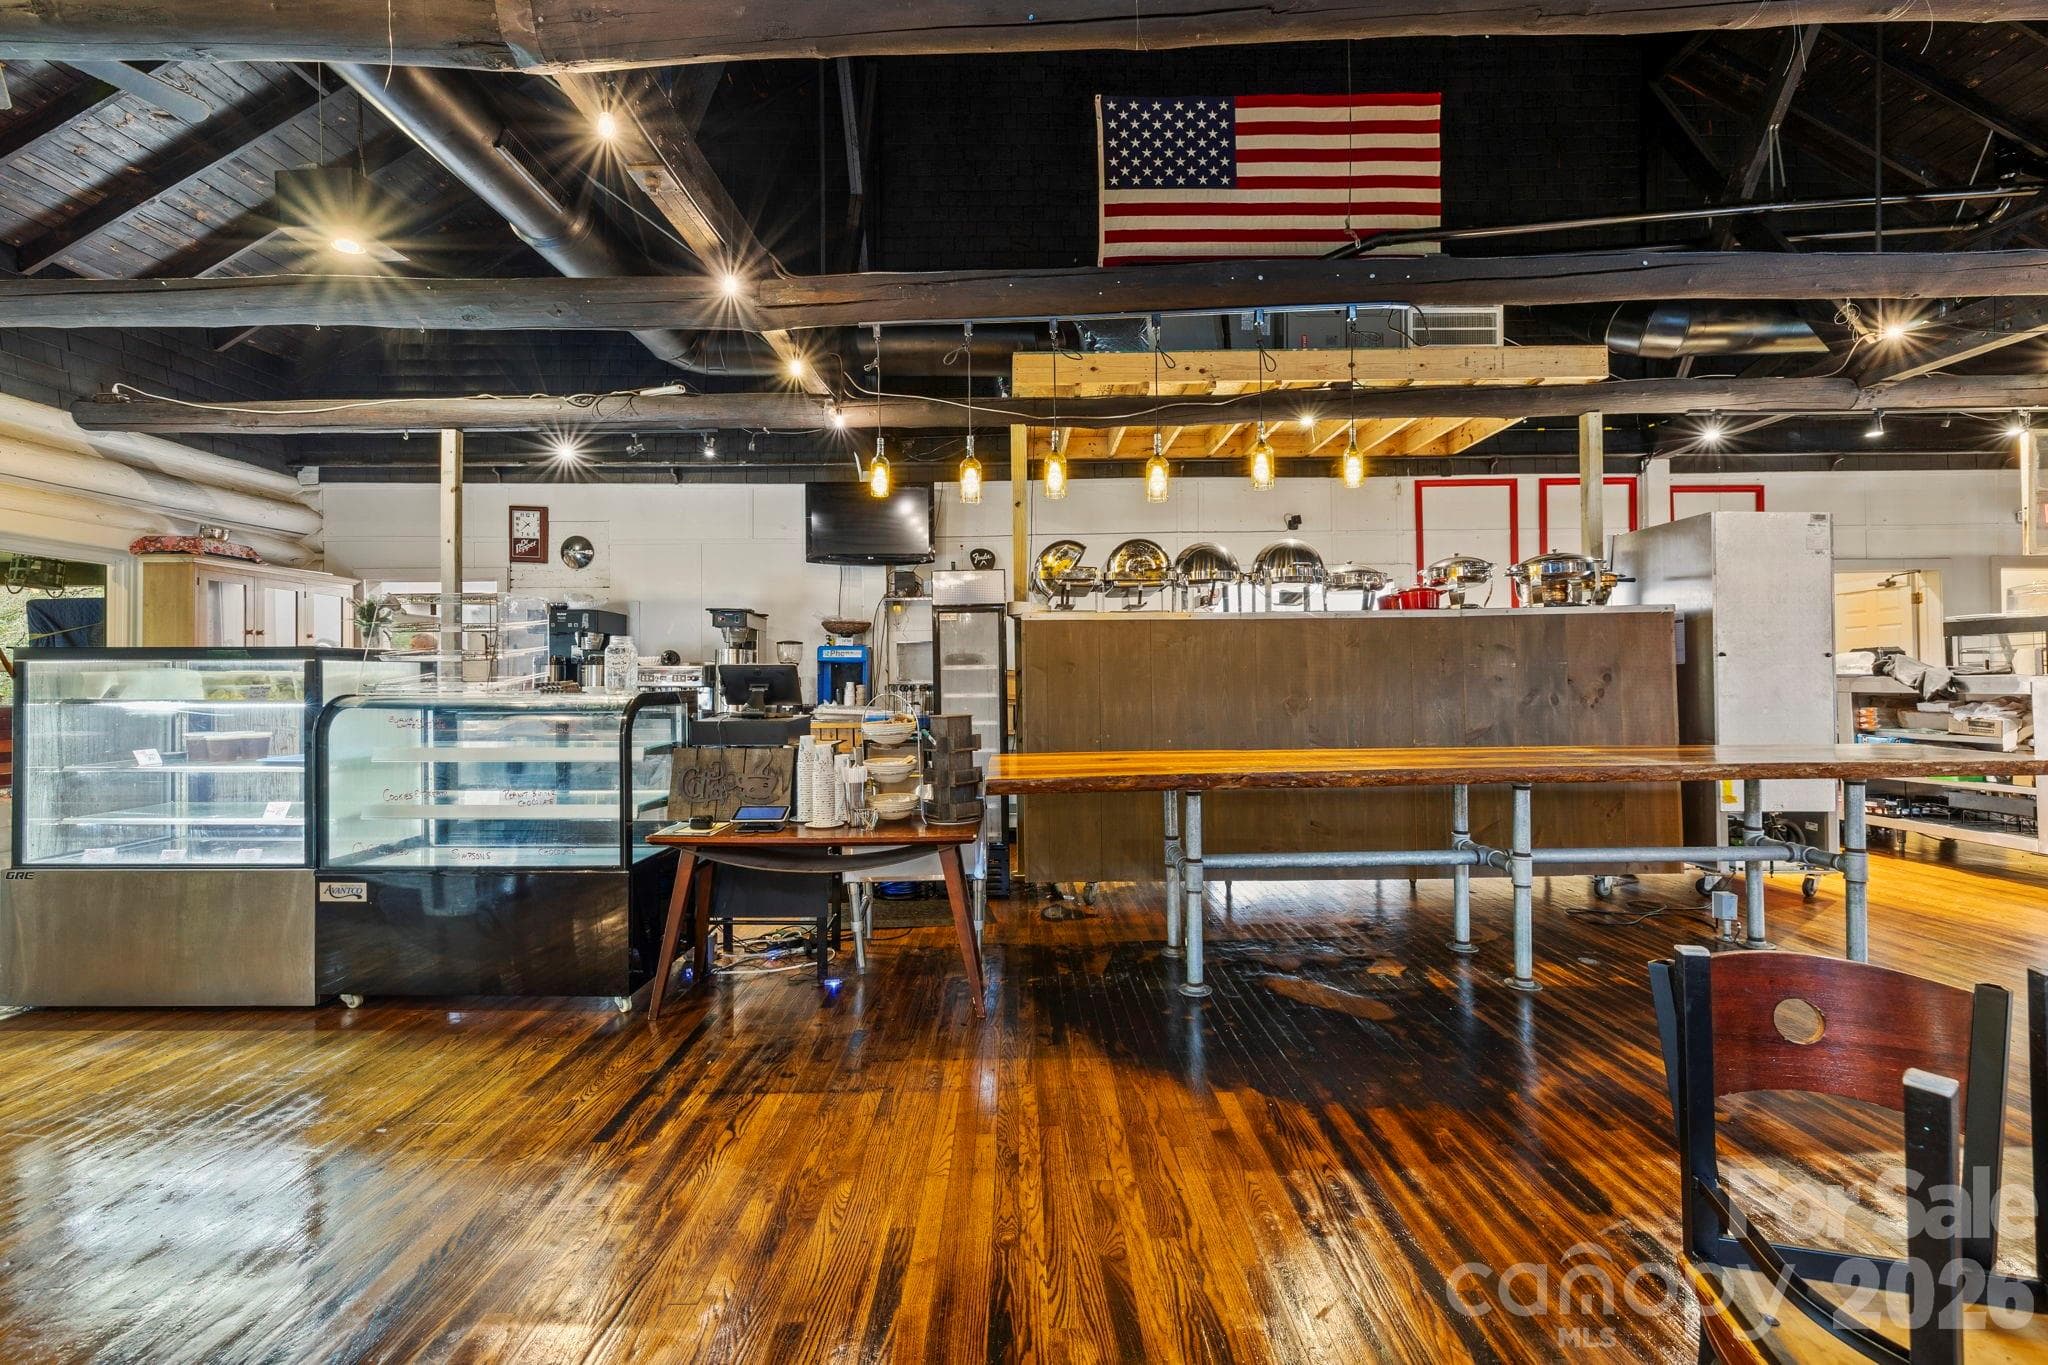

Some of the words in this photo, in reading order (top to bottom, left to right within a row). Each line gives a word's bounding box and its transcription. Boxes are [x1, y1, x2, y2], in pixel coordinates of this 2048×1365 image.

[515, 540, 537, 554] Pepper
[972, 552, 993, 564] Fender
[323, 884, 363, 899] AVANTCO
